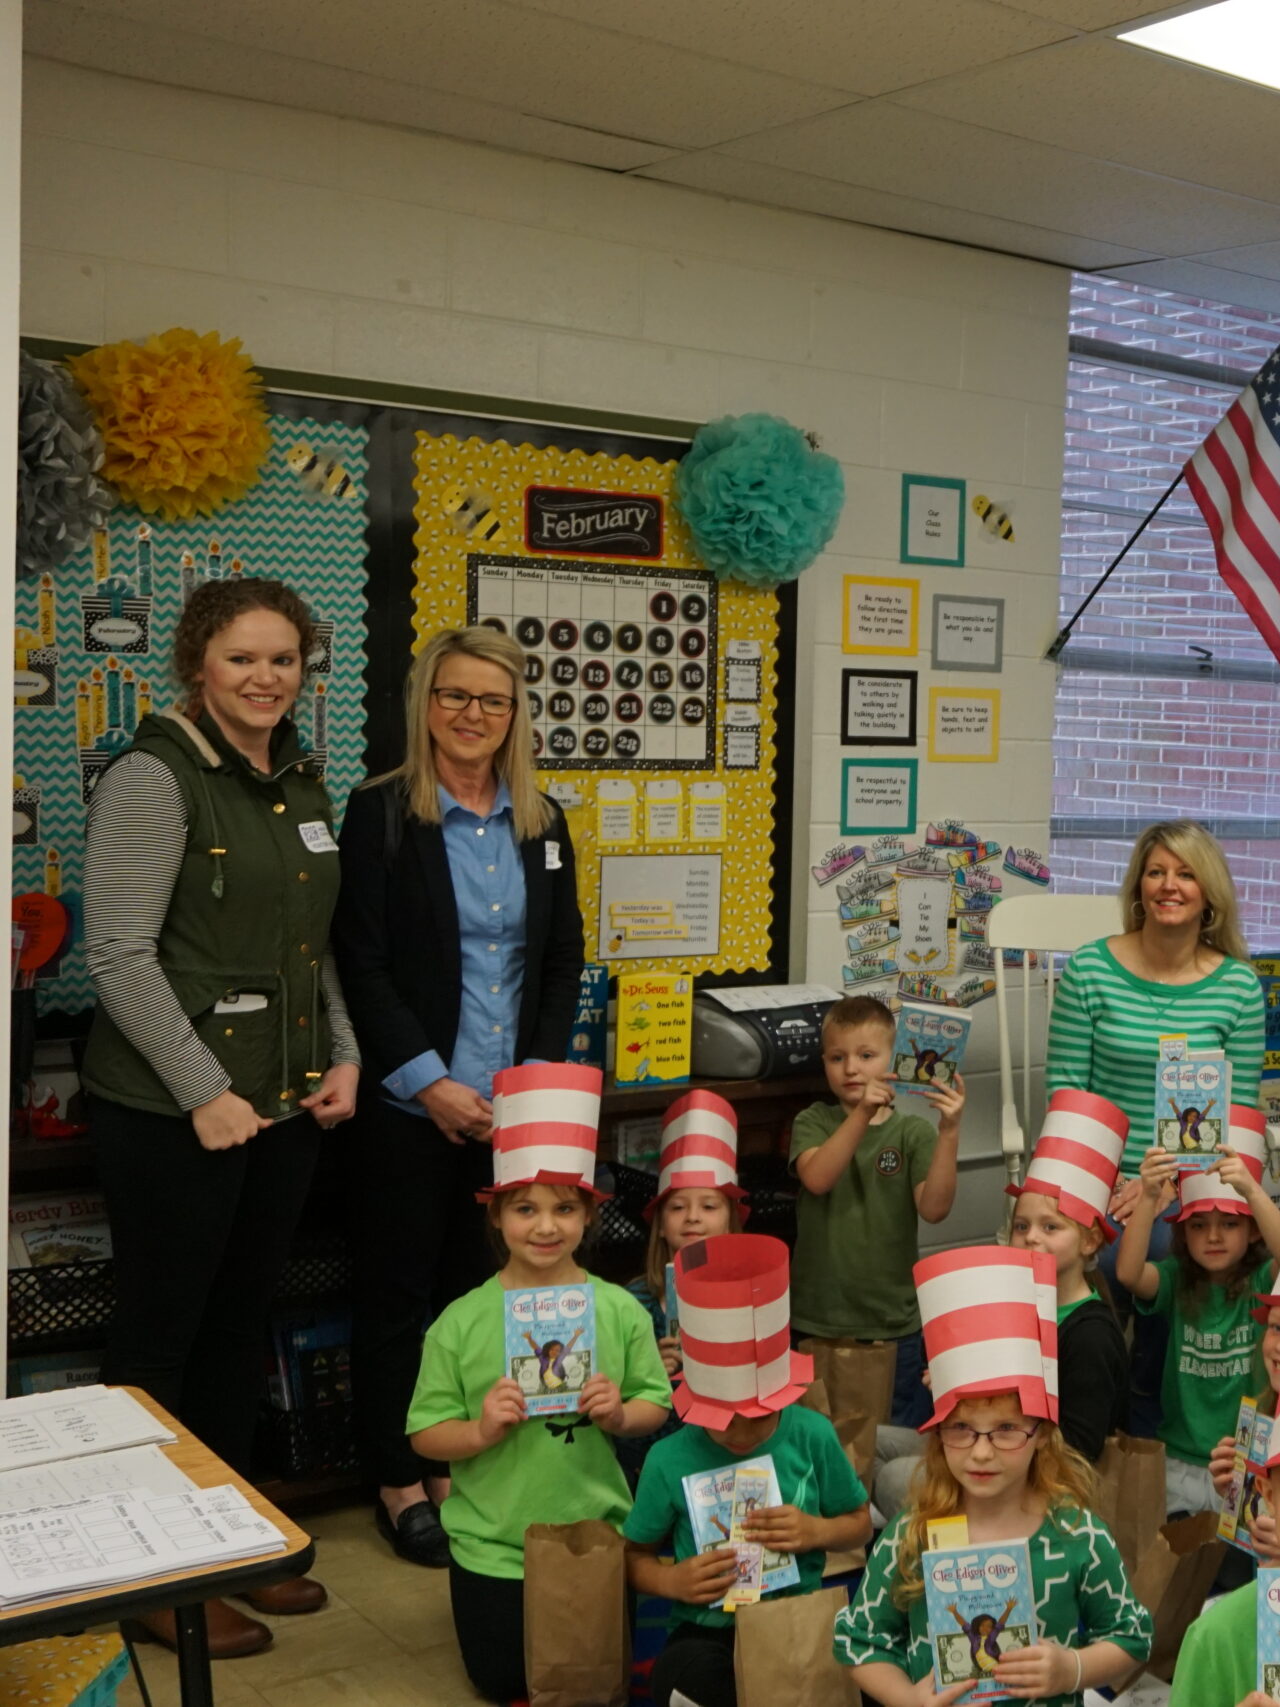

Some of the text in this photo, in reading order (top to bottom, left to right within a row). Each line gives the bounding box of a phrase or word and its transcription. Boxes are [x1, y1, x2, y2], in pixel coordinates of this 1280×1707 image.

[541, 507, 649, 538] February
[481, 567, 706, 591] Sunday Monday Tuesday Wednesday Thursday Friday Saturday
[875, 596, 892, 604] ready
[660, 601, 699, 615] 1 2
[878, 606, 907, 614] directions
[42, 610, 51, 635] Noah
[953, 614, 984, 623] responsible
[858, 625, 872, 634] they
[525, 625, 699, 650] 4 5 6 7 8 9
[556, 665, 574, 679] 12
[587, 668, 605, 682] 13
[621, 667, 638, 684] 14
[653, 670, 670, 683] 15
[685, 670, 701, 683] 16
[867, 680, 902, 688] considerate
[553, 699, 702, 717] 19 20 21 22 23
[862, 701, 884, 709] walking
[974, 706, 988, 714] keep
[854, 711, 874, 719] talking
[941, 726, 963, 734] objects
[553, 734, 573, 748] 26
[586, 736, 607, 749] 27
[616, 736, 636, 751] 28
[866, 777, 897, 785] respectful
[580, 969, 602, 984] AT
[645, 982, 669, 994] Seuss
[574, 1008, 604, 1024] AT
[905, 1013, 964, 1039] CEO
[656, 1037, 666, 1045] red
[1162, 1064, 1219, 1090] CEO
[1199, 1072, 1219, 1081] Oliver
[512, 1290, 587, 1322] CEO
[561, 1299, 585, 1309] Oliver
[1179, 1355, 1250, 1378] ELEMENTAR
[932, 1564, 1016, 1581] Cleo Edison Oliver
[932, 1553, 1019, 1593] CEO
